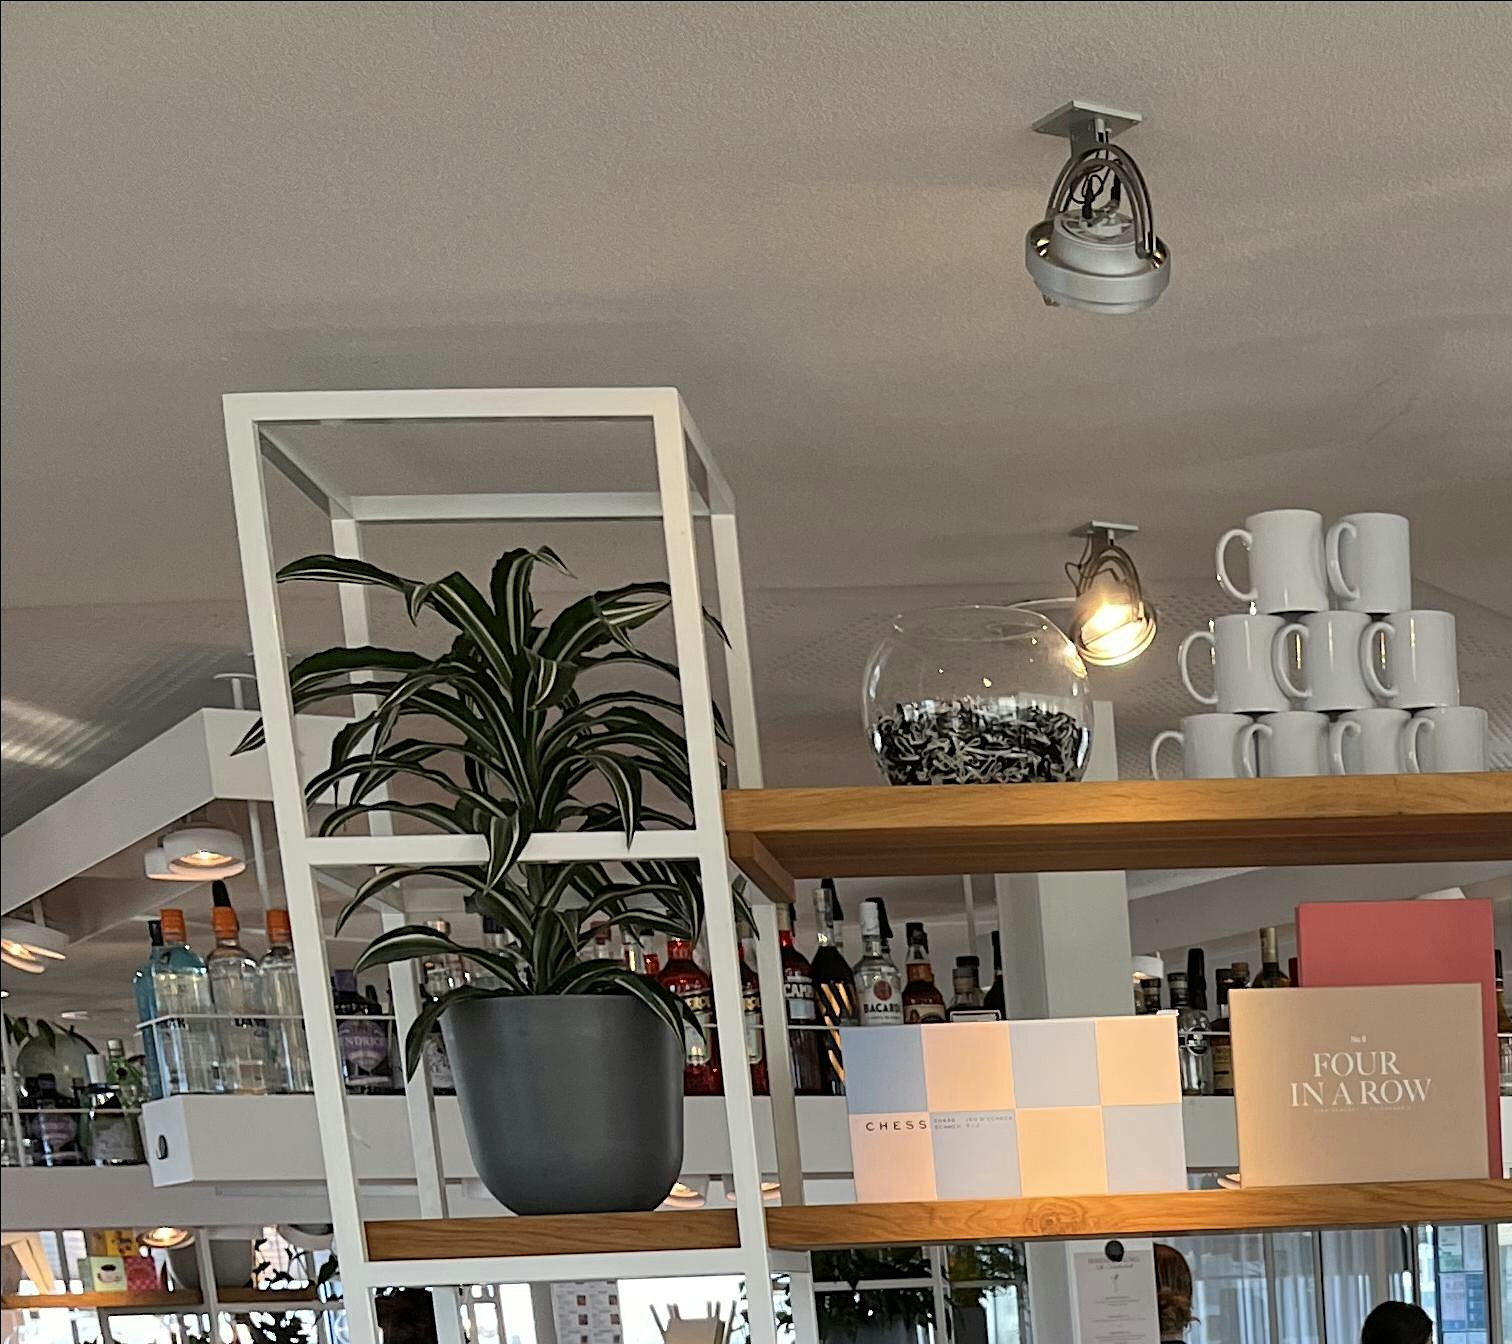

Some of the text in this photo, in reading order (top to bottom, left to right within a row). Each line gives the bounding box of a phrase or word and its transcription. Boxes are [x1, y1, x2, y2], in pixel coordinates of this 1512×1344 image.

[1313, 1051, 1400, 1077] FOUR
[1290, 1078, 1431, 1107] IN A ROW
[865, 1120, 928, 1131] CHESS
